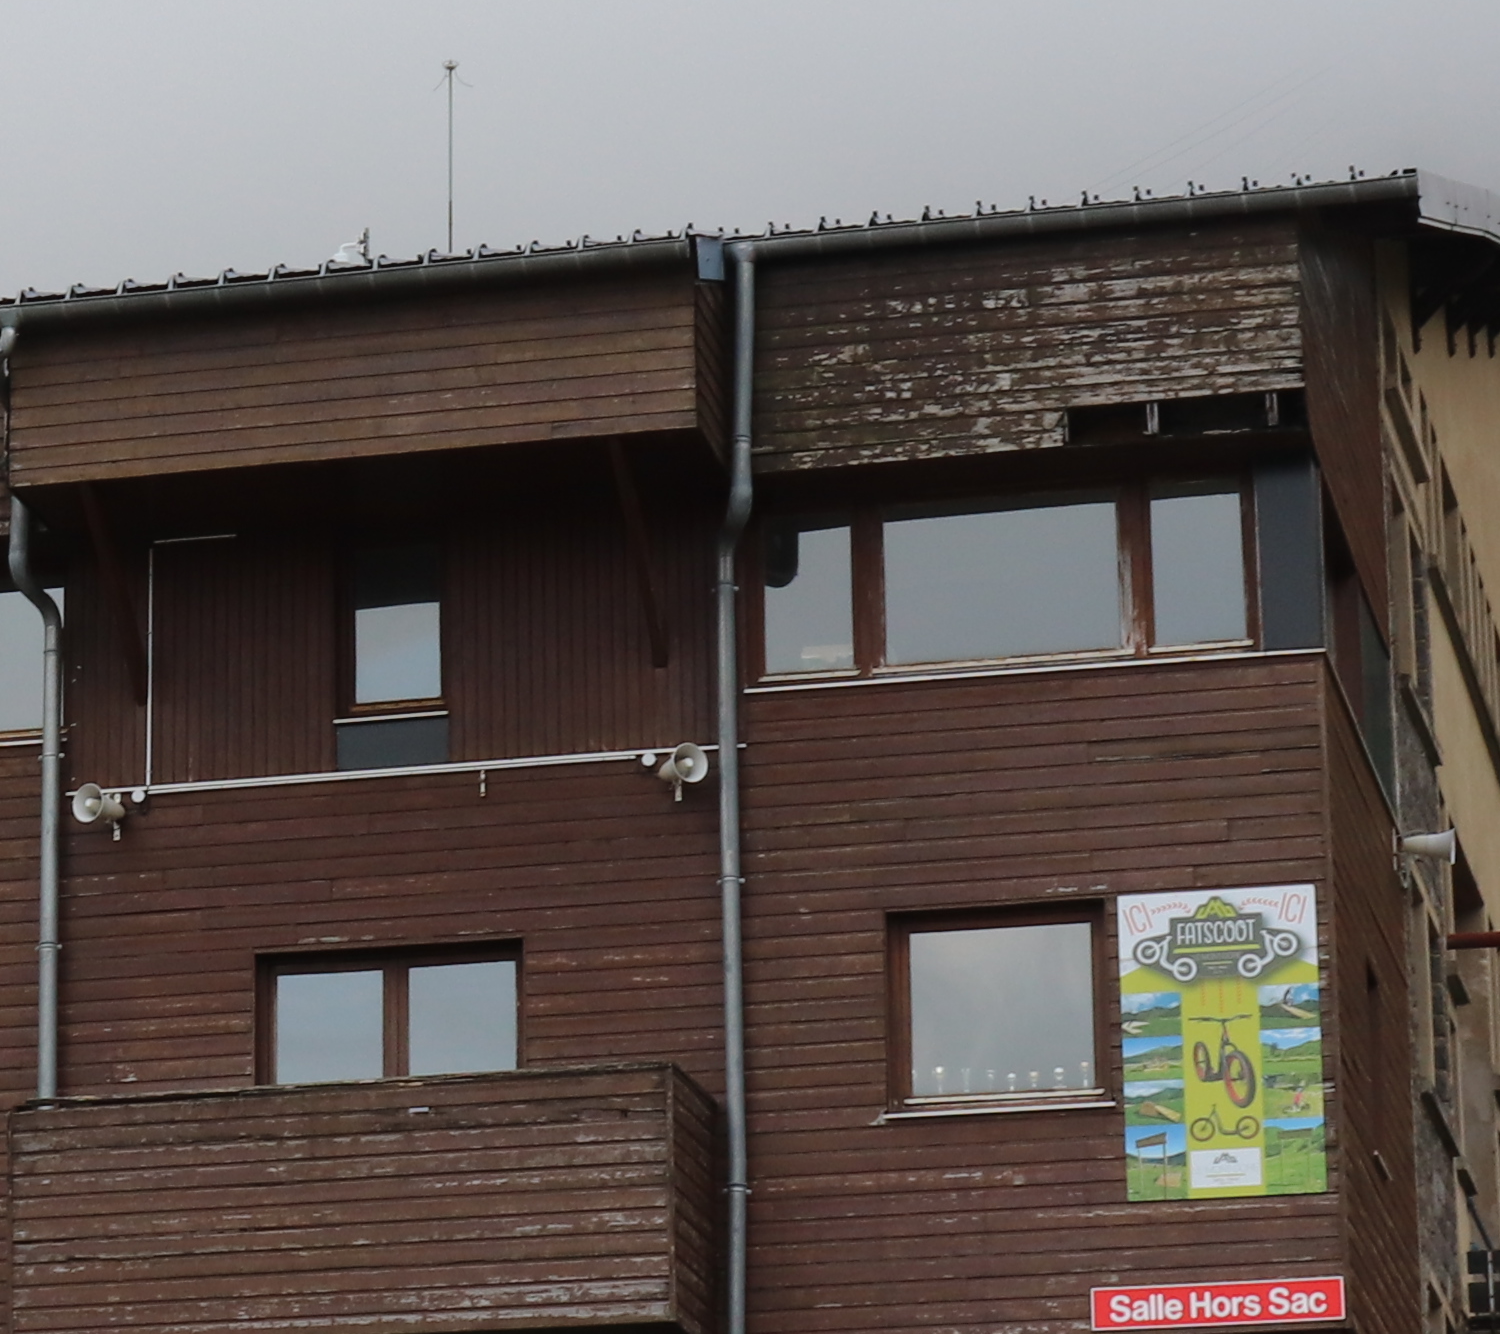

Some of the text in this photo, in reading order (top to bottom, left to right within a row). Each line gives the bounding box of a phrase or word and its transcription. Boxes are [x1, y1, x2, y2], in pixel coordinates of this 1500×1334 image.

[1122, 902, 1153, 935] ICI
[1278, 892, 1307, 924] ICI
[1176, 919, 1256, 945] FATSCOOT
[1109, 1286, 1328, 1323] Salle Hors Sac
